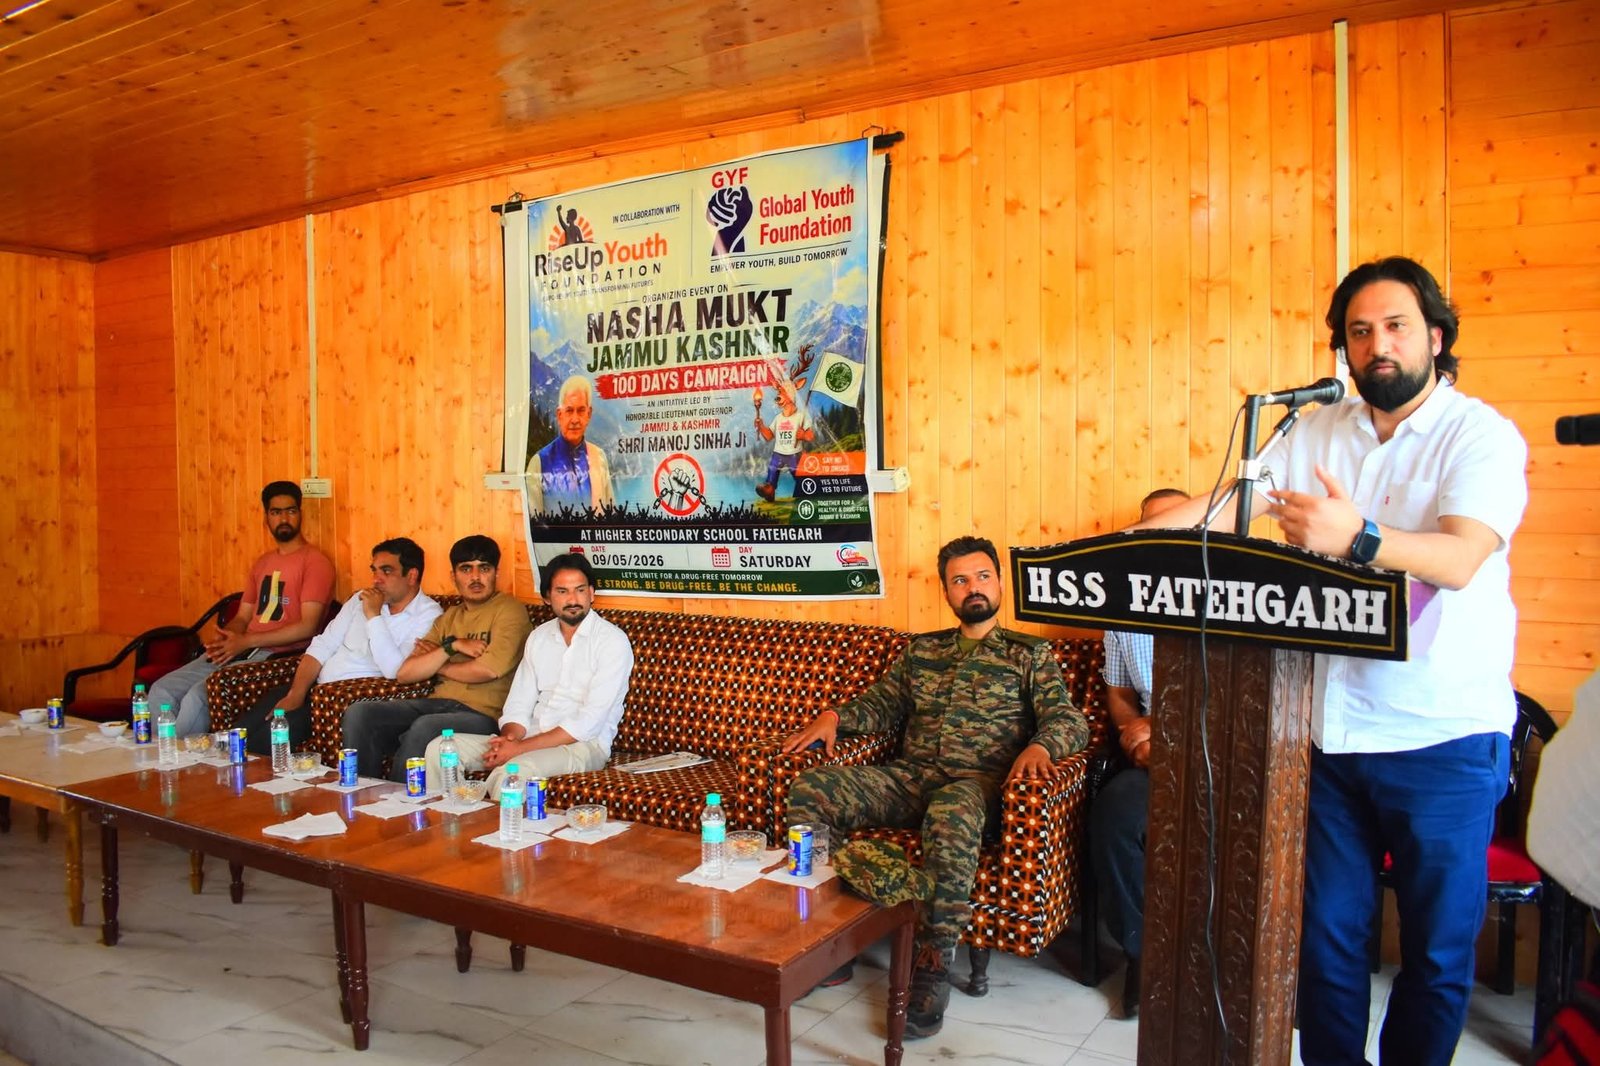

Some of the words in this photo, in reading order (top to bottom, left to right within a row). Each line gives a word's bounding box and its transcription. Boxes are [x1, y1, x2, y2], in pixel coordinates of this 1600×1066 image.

[711, 167, 748, 188] GYF
[760, 191, 806, 218] Global
[812, 184, 854, 210] Youth
[612, 216, 620, 224] IN
[620, 207, 664, 222] COLLABORATION
[665, 204, 680, 214] WITH
[760, 214, 852, 245] Foundation
[748, 258, 777, 268] YOUTH,
[778, 254, 801, 265] BUILD
[804, 248, 848, 261] TOMORROW
[642, 290, 687, 304] ORGANIZING
[689, 286, 716, 297] EVENT
[717, 284, 729, 294] ON
[587, 300, 686, 344] NASHA
[696, 288, 793, 331] MUKT
[586, 338, 668, 374] JAMMU
[676, 326, 790, 364] KASHMIR
[612, 375, 637, 395] 100
[641, 371, 679, 392] DAYS
[683, 363, 768, 389] CAMPAIGN
[656, 399, 688, 408] INITIATIVE
[625, 412, 660, 422] HONORABLE
[661, 409, 698, 418] LIEUTENANT
[698, 406, 733, 416] GOVERNOR
[640, 422, 670, 434] JAMMU
[672, 422, 678, 430] &
[681, 419, 720, 430] KASHMIR
[780, 431, 793, 440] YES
[618, 437, 644, 454] SHRI
[648, 434, 690, 452] MANOJ
[694, 432, 732, 450] SINHA
[735, 431, 746, 448] JI
[580, 529, 592, 541] AT
[595, 529, 632, 541] HIGHER
[636, 529, 700, 541] SECONDARY
[703, 528, 750, 542] SCHOOL
[752, 527, 822, 541] FATEHGARH
[592, 554, 664, 567] 09/05/2026
[740, 556, 812, 568] SATURDAY
[604, 580, 642, 588] STRONG.
[645, 580, 656, 589] BE
[660, 582, 716, 591] DRUG-FREE.
[720, 583, 731, 592] BE
[734, 582, 752, 592] THE
[756, 583, 802, 592] CHANGE.
[1027, 566, 1106, 608] H.S.S
[1128, 573, 1387, 635] FATEHGARH
